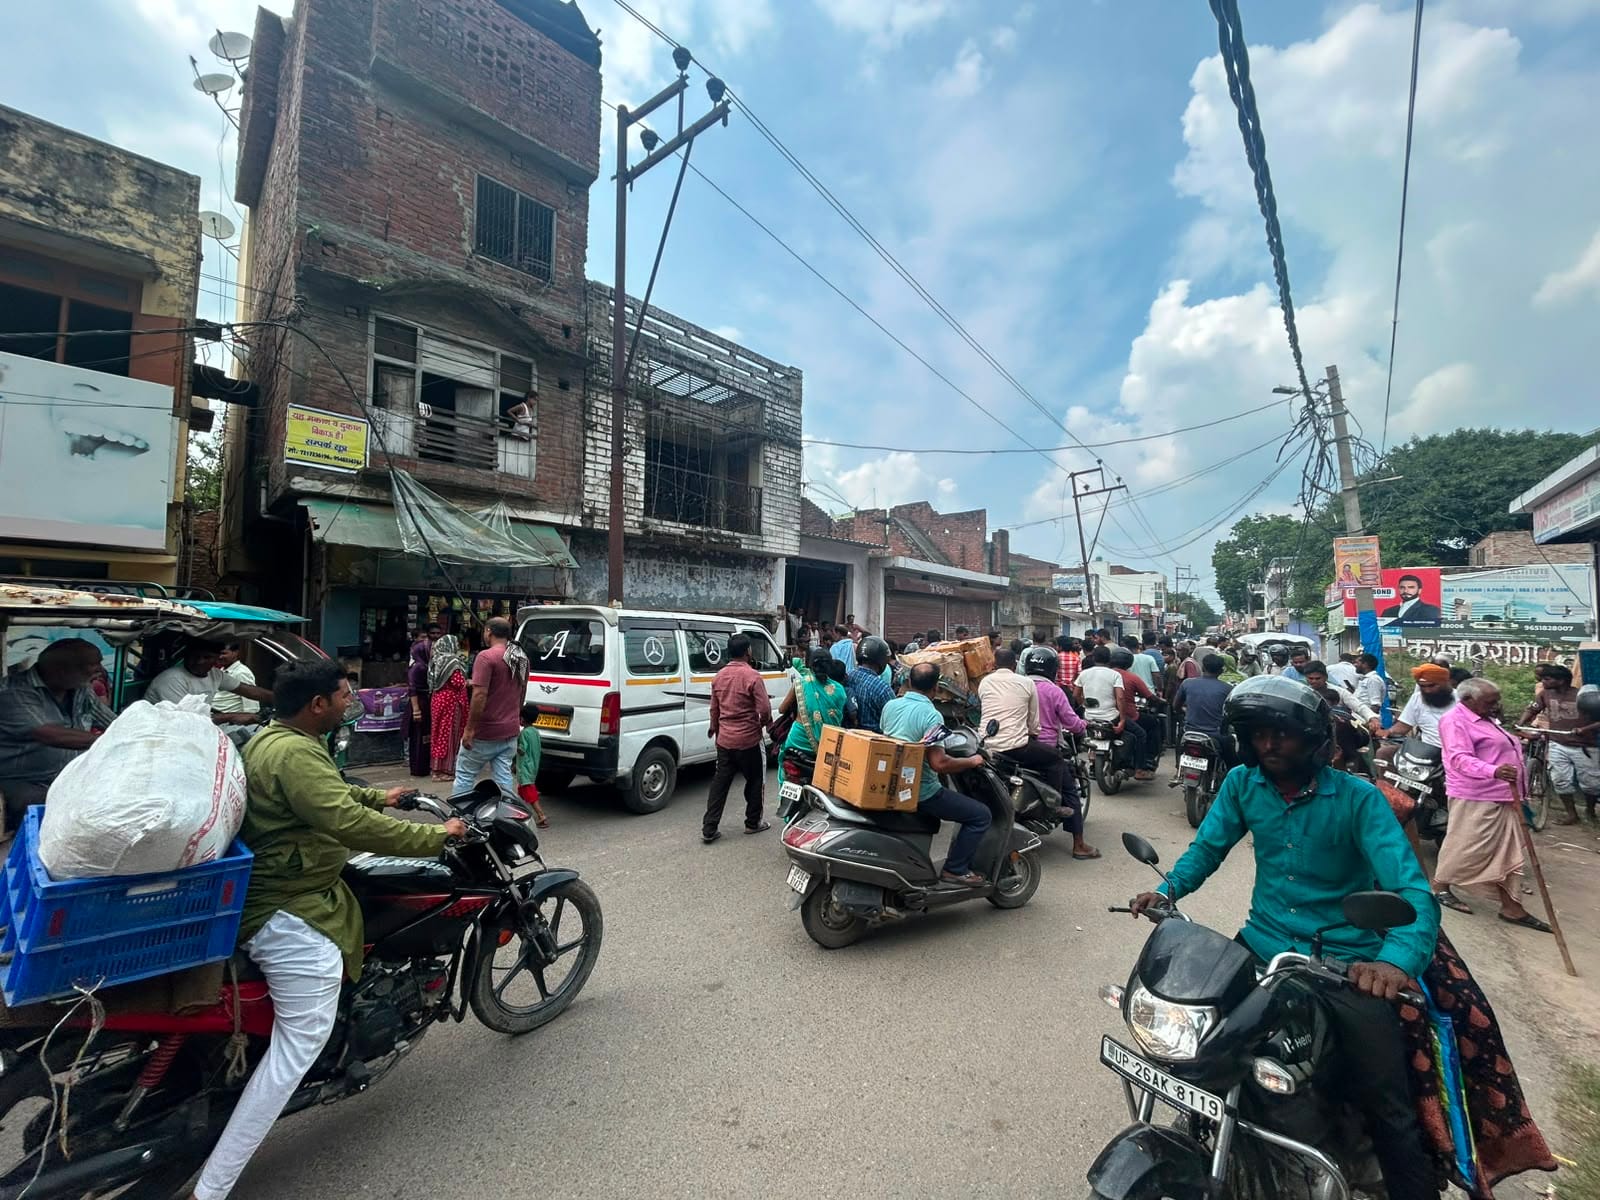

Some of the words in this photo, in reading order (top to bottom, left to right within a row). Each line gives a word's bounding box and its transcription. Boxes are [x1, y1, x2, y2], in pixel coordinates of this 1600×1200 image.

[340, 423, 361, 432] दुकान
[540, 630, 570, 661] A
[1294, 1033, 1312, 1048] Hero
